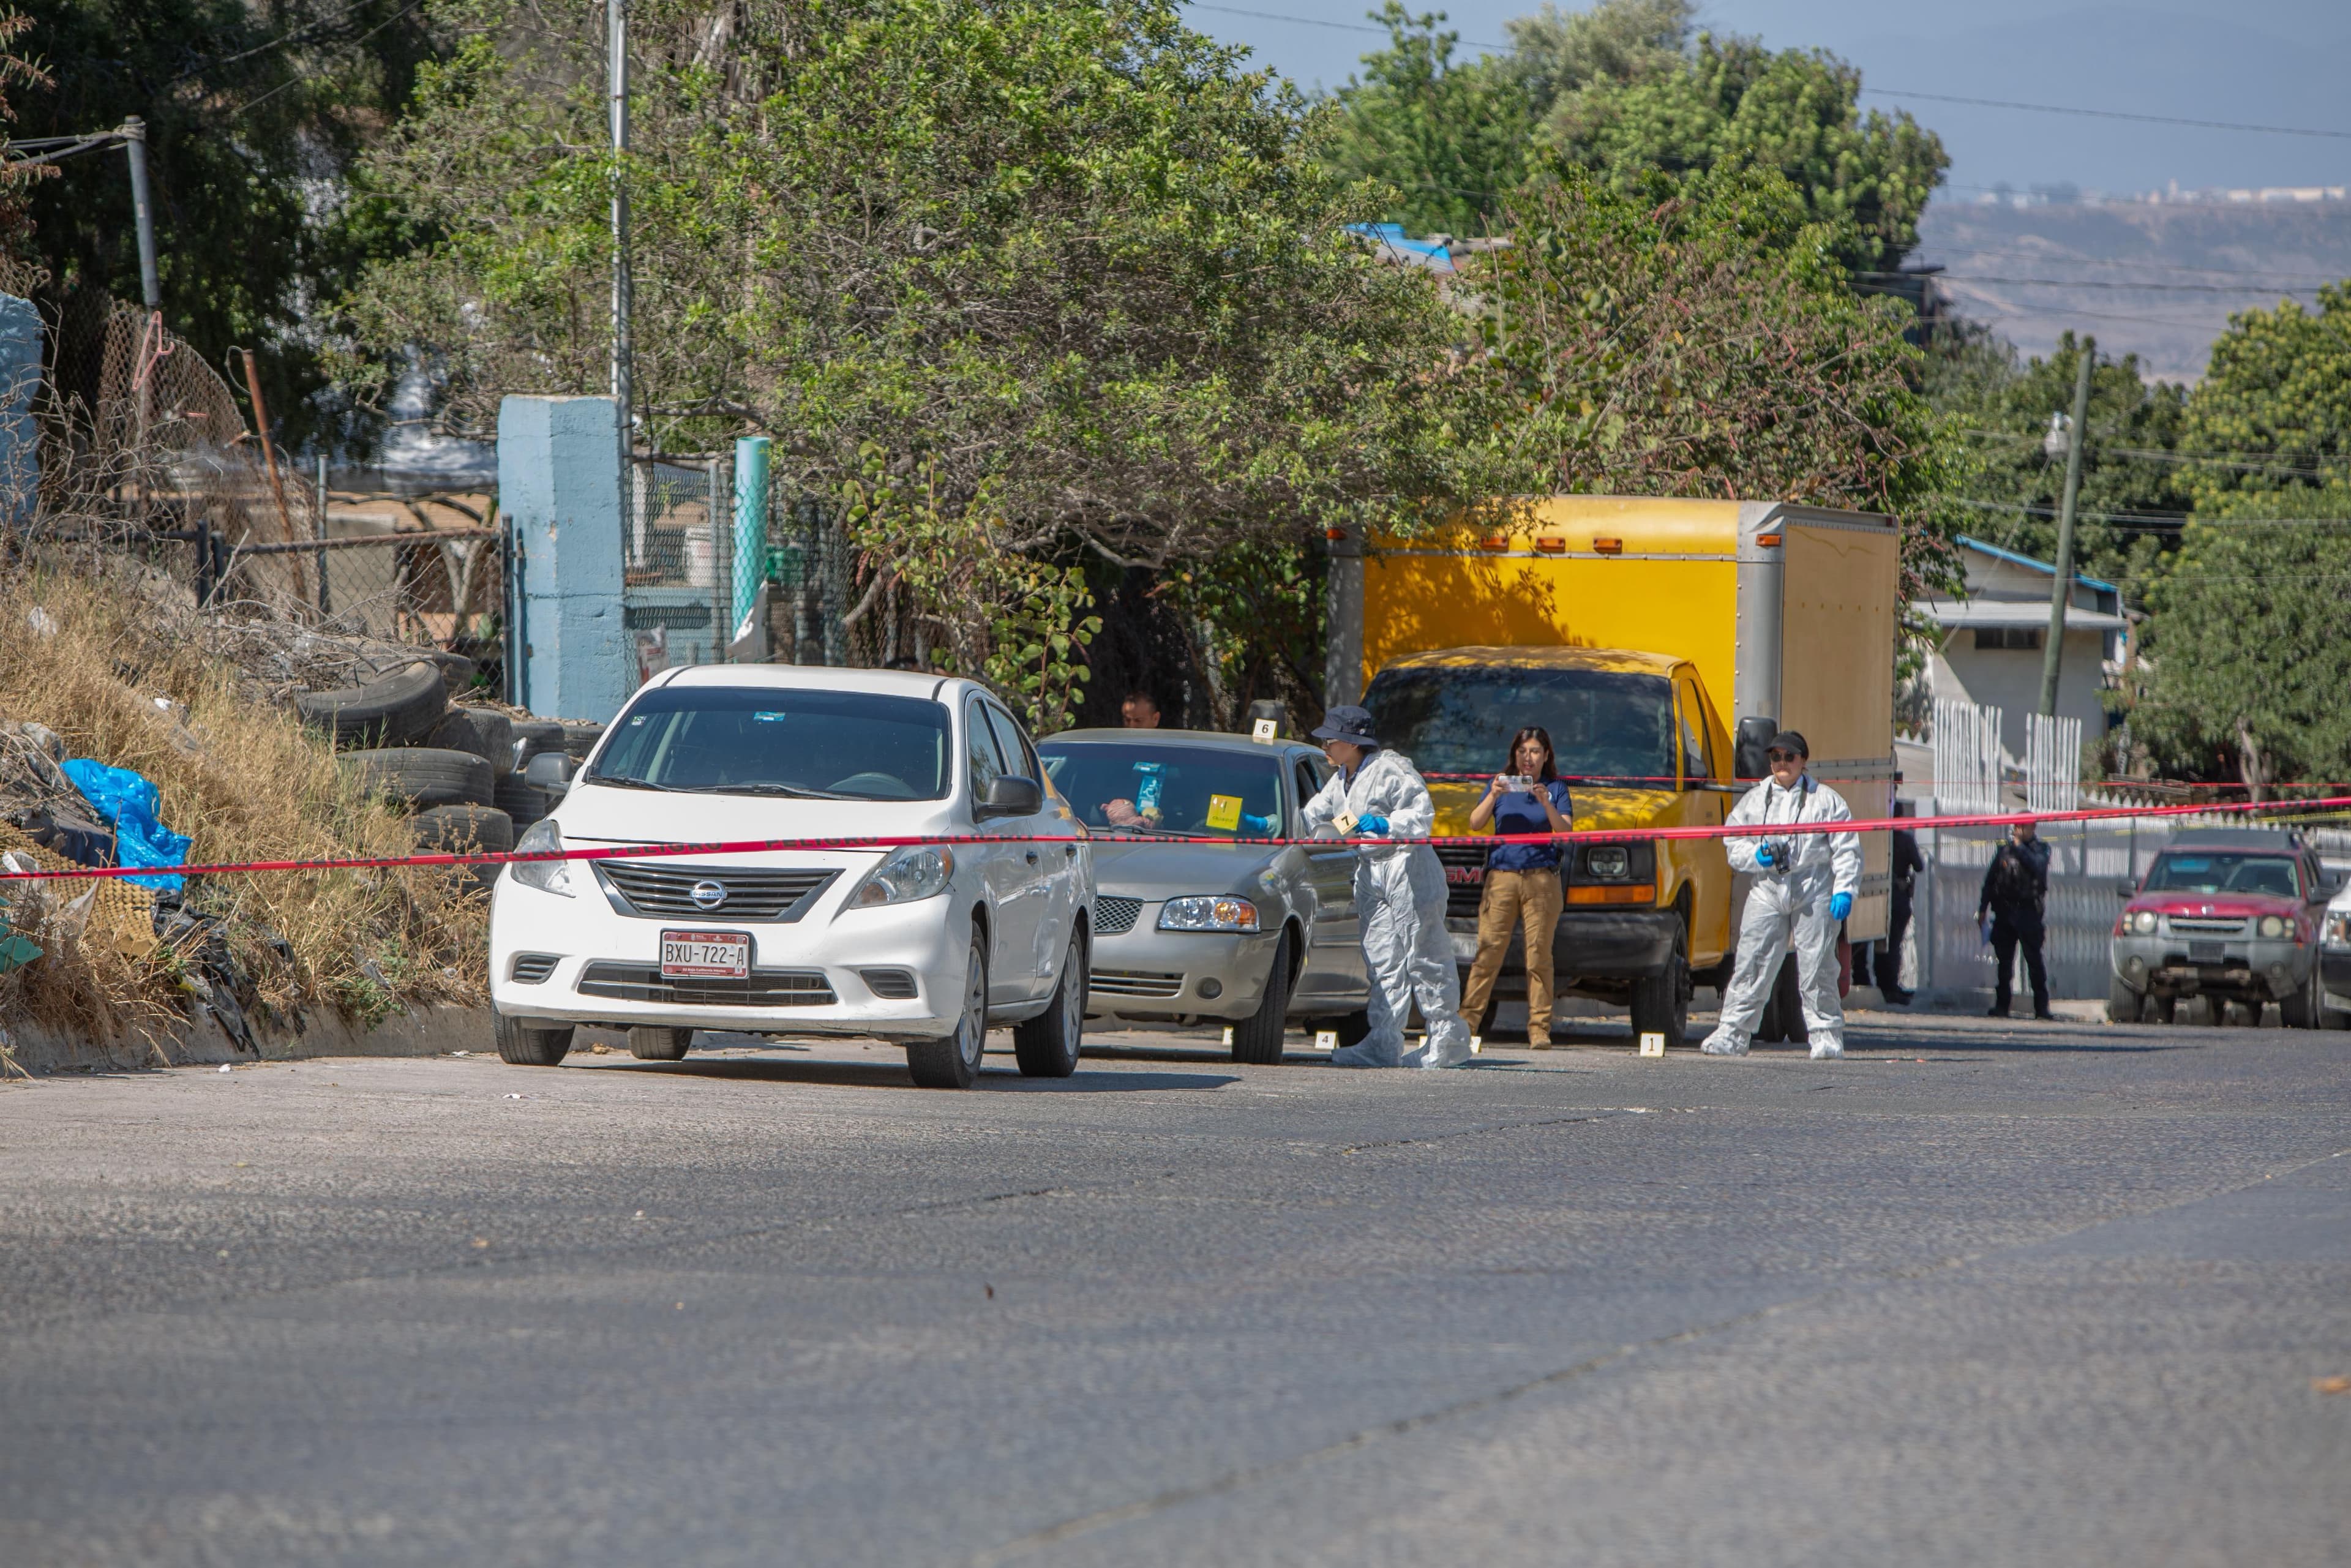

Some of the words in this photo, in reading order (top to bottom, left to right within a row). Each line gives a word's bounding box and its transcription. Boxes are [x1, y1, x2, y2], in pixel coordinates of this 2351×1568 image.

[1262, 724, 1269, 733] 6
[1341, 815, 1349, 826] 7
[1445, 866, 1484, 882] GM
[666, 943, 744, 966] BXU-722-A
[1648, 1037, 1655, 1052] 1
